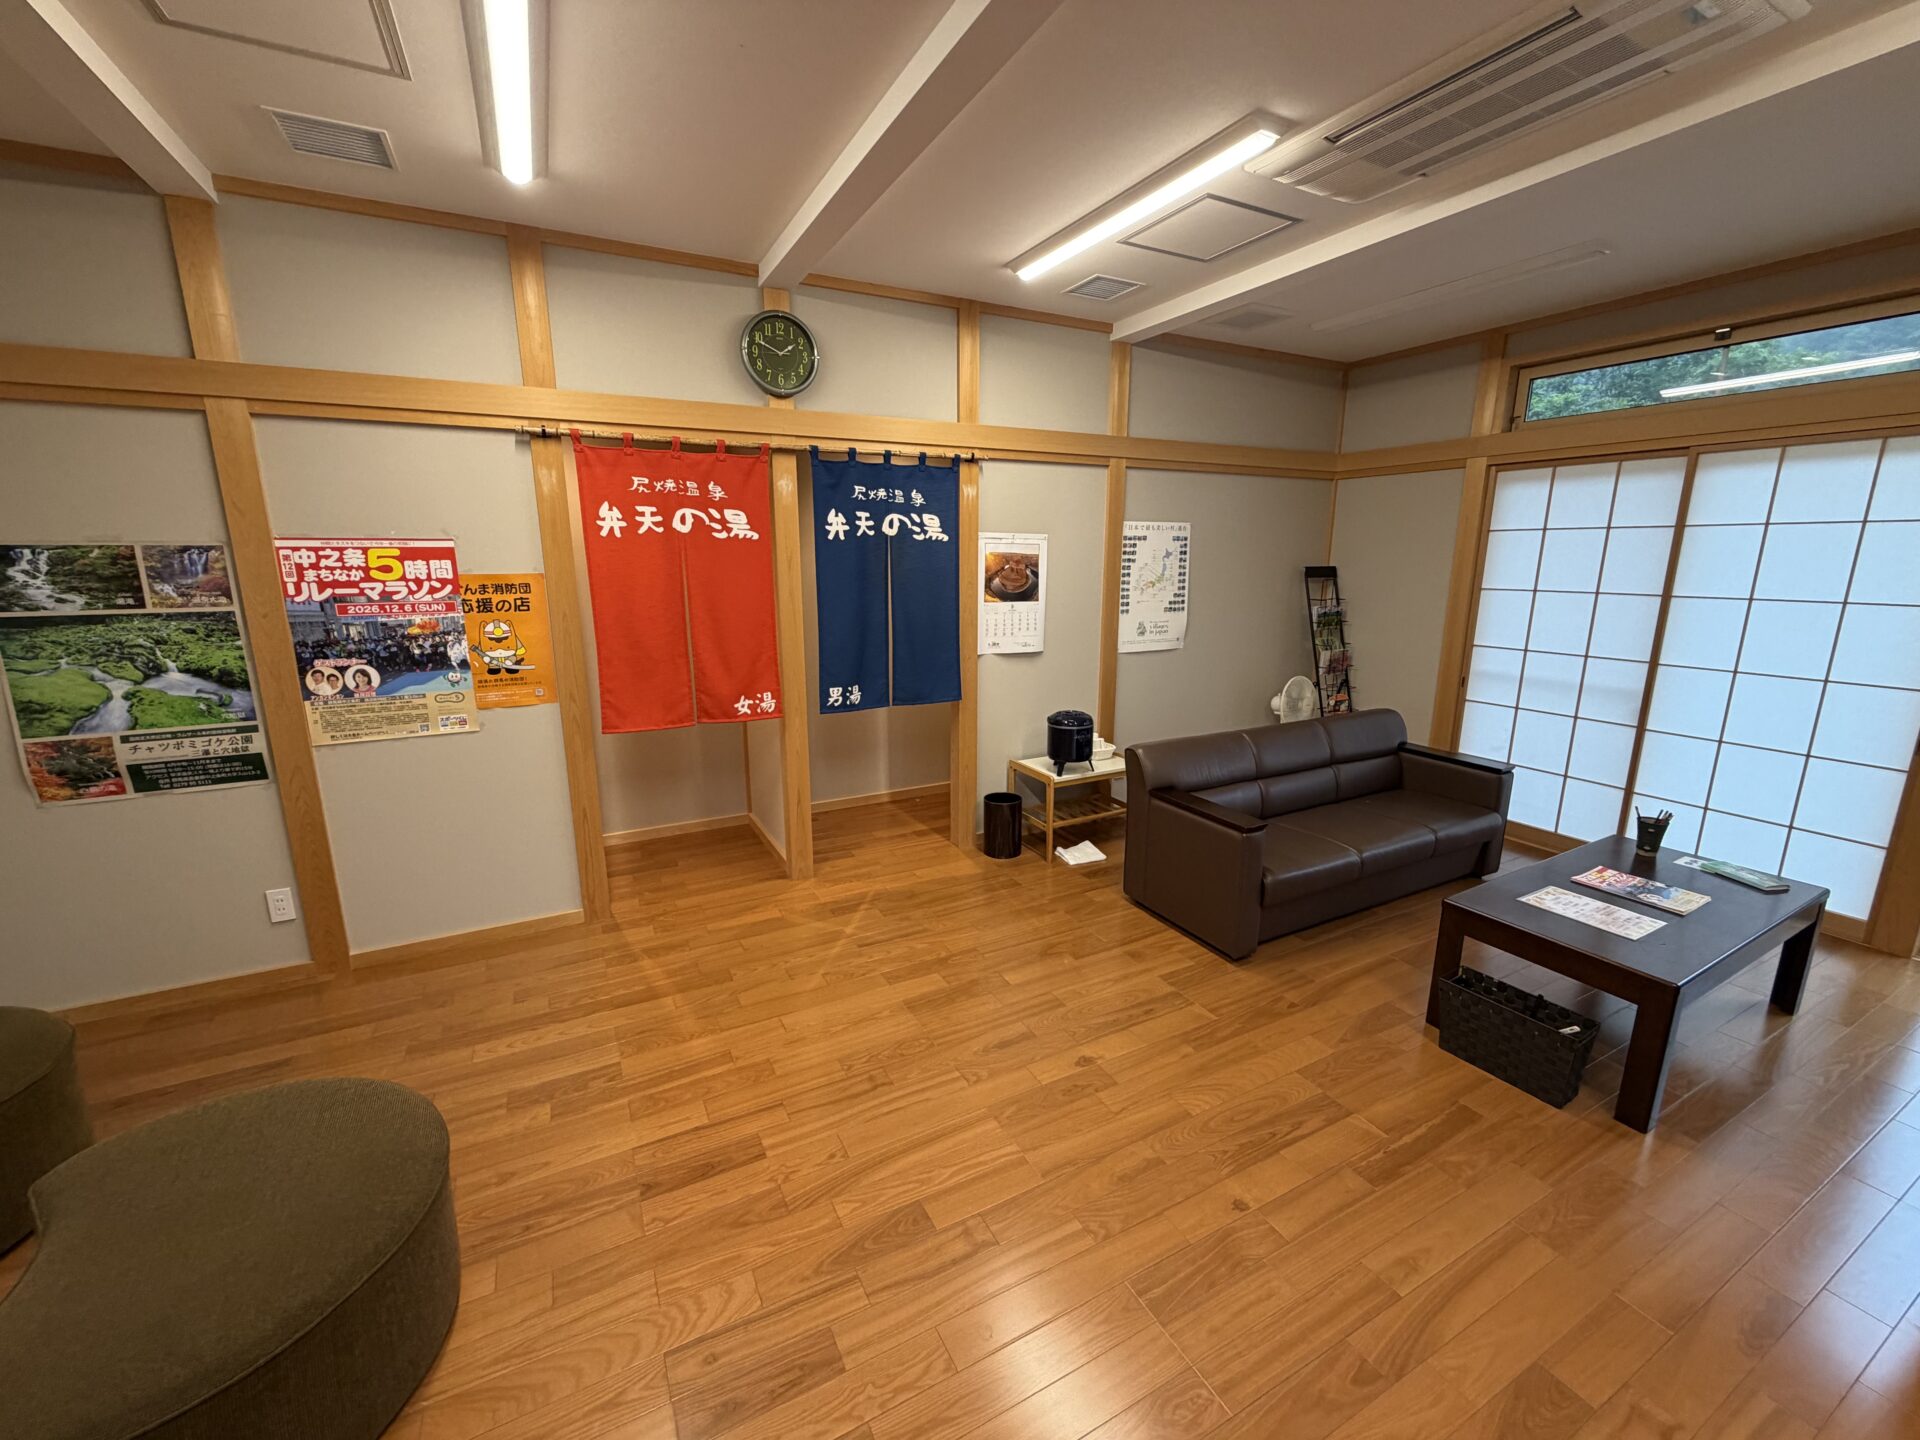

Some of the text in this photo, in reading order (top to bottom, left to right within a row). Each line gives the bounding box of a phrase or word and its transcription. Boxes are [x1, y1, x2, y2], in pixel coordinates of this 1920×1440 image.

[764, 323, 772, 336] 11
[775, 322, 784, 335] 12
[790, 327, 794, 339] 1
[755, 331, 763, 344] 10
[798, 337, 804, 350] 2
[752, 345, 758, 357] 9
[802, 352, 808, 364] 3
[756, 359, 762, 371] 8
[798, 364, 804, 376] 4
[766, 369, 772, 381] 7
[778, 373, 785, 386] 6
[790, 372, 796, 384] 5
[595, 501, 760, 540] 弁天の湯
[825, 508, 949, 541] 弁天の湯
[293, 548, 366, 568] 中之条
[282, 554, 295, 578] 第12回
[303, 569, 365, 582] まちなか
[286, 580, 454, 602] リレーマラソン
[460, 583, 531, 595] んま消防団
[347, 602, 446, 614] 2026.12.6 (SUN)
[826, 685, 862, 707] 男湯
[734, 691, 776, 715] 女湯
[128, 735, 253, 754] チャツボミゴケ公園
